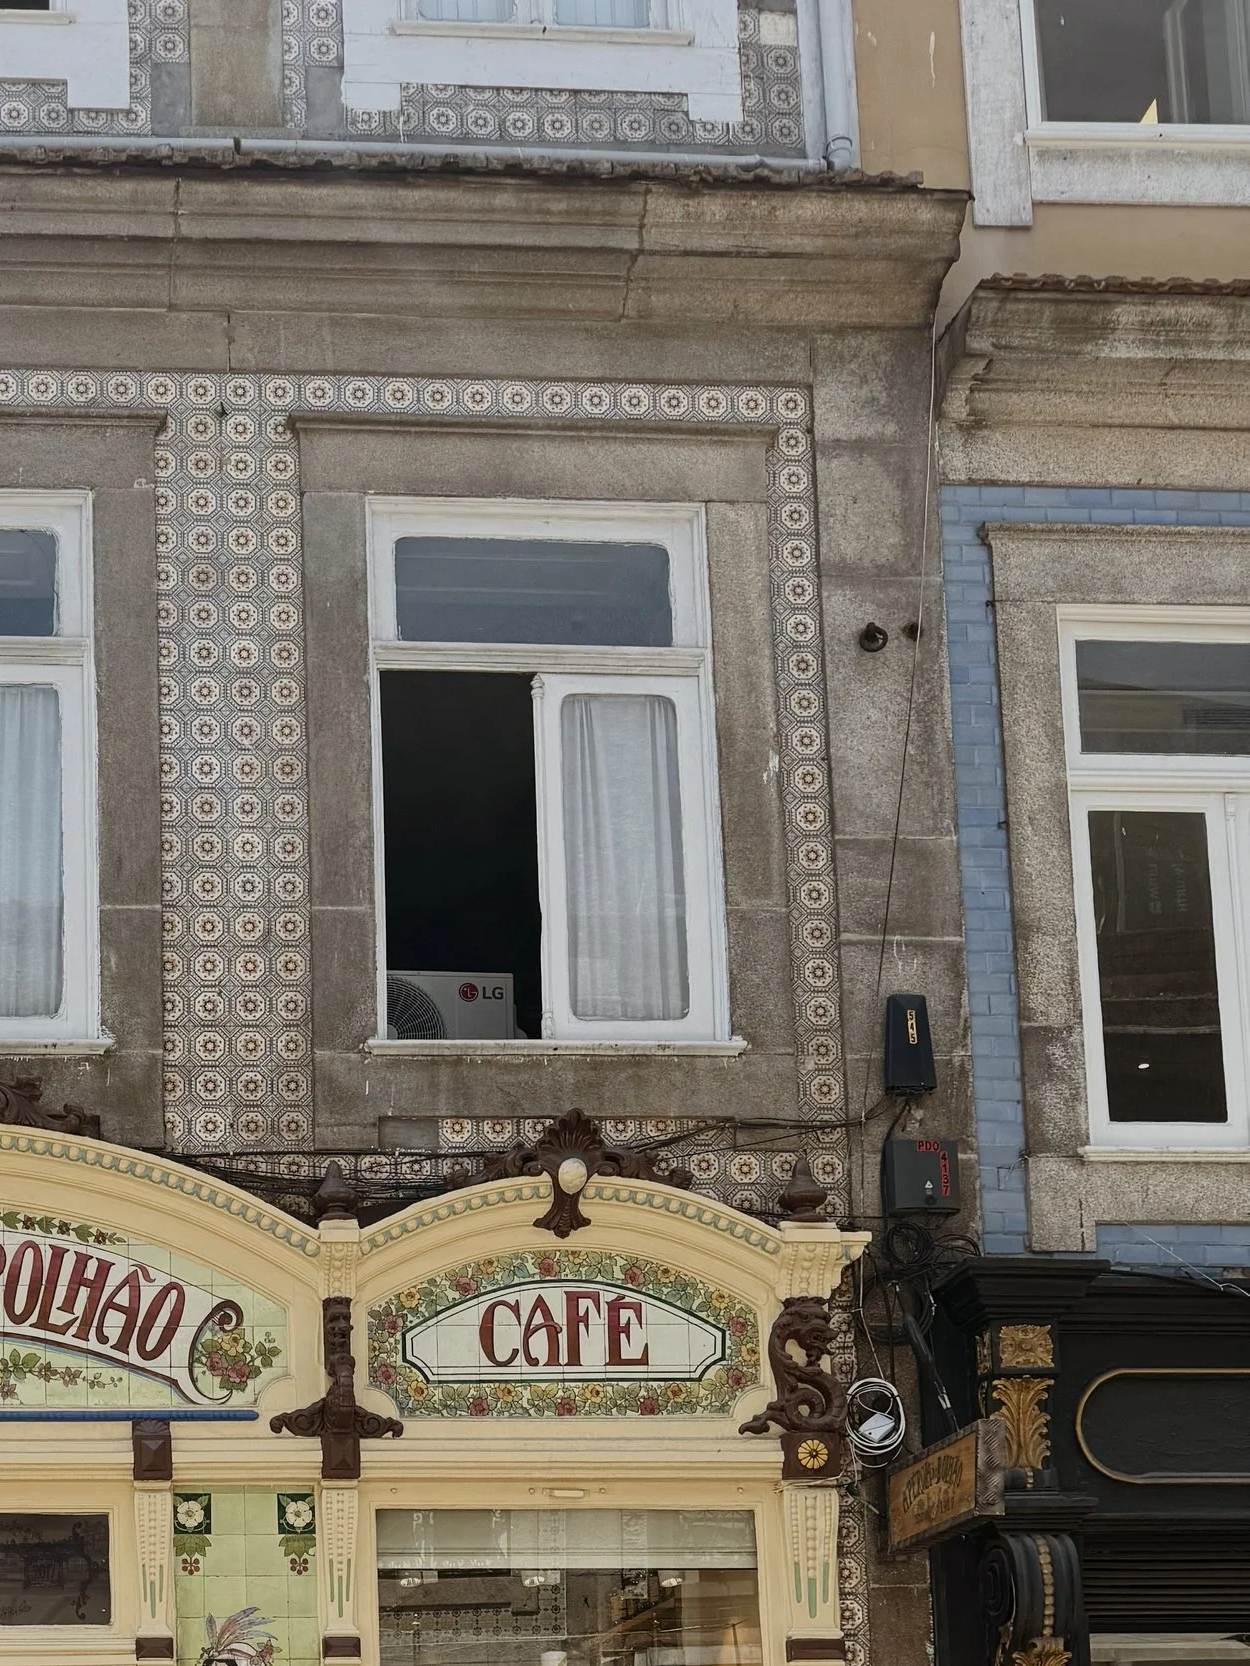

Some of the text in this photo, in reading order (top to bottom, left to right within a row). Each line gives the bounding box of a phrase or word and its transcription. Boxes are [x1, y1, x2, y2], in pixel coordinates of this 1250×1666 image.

[482, 986, 504, 1000] LG
[907, 1010, 917, 1043] 545
[918, 1141, 939, 1151] PDO
[940, 1152, 950, 1196] 4137
[478, 1290, 649, 1367] CAFÉ
